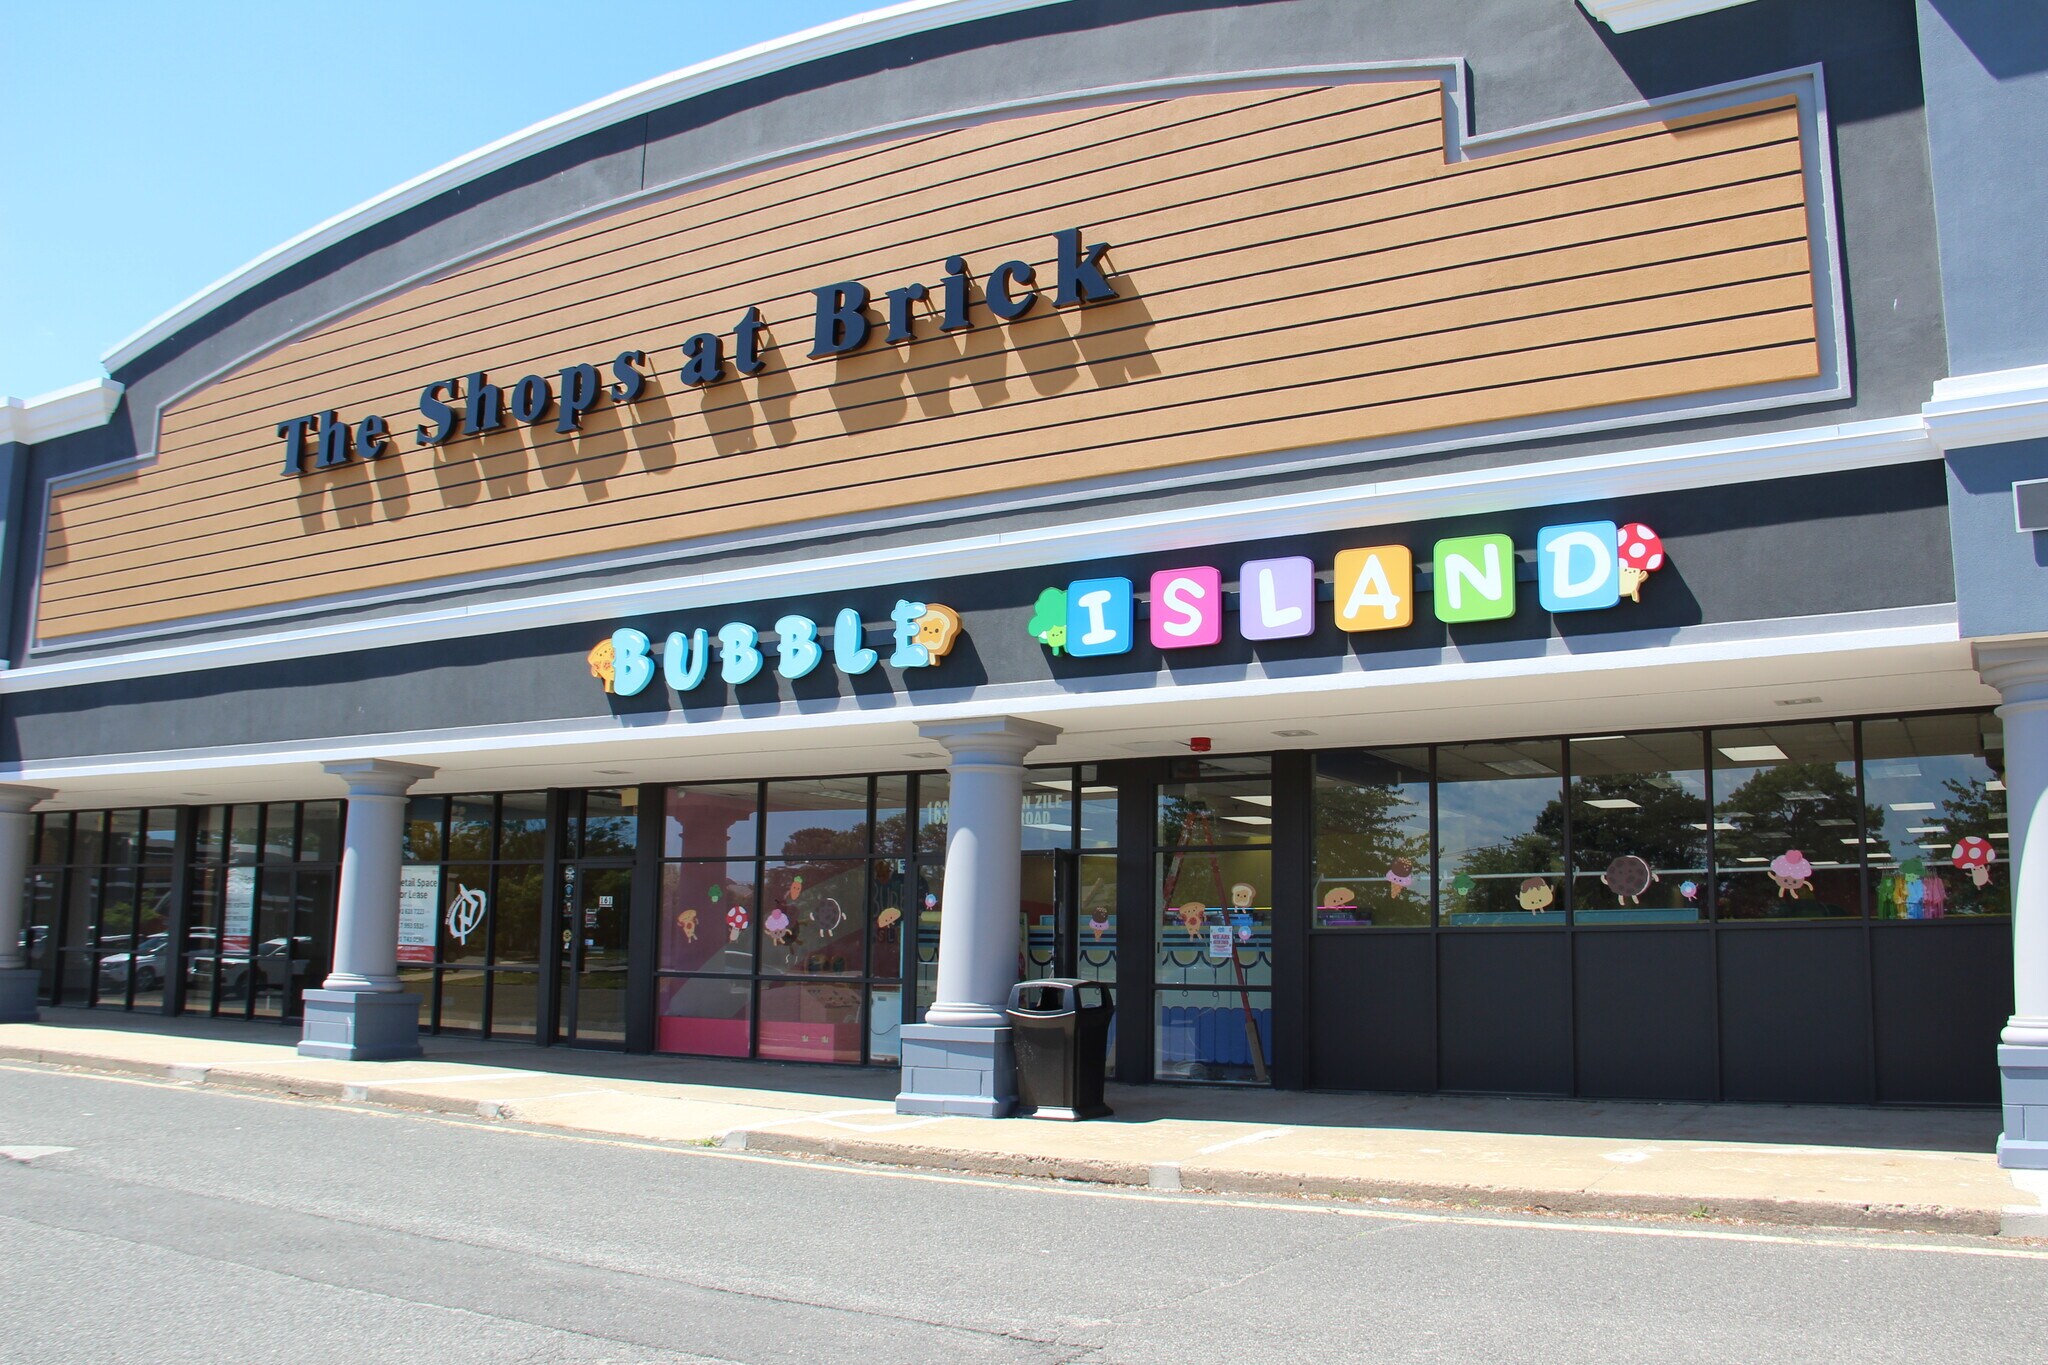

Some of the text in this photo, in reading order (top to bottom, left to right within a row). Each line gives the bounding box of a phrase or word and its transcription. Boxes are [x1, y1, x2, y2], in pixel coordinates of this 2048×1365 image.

[276, 227, 1122, 476] The Shops at Brick
[612, 530, 1612, 697] BUBBLE ISLAND
[926, 800, 949, 826] 163
[1035, 794, 1063, 809] ZILE
[400, 878, 438, 889] etail Space
[408, 889, 428, 899] Lease
